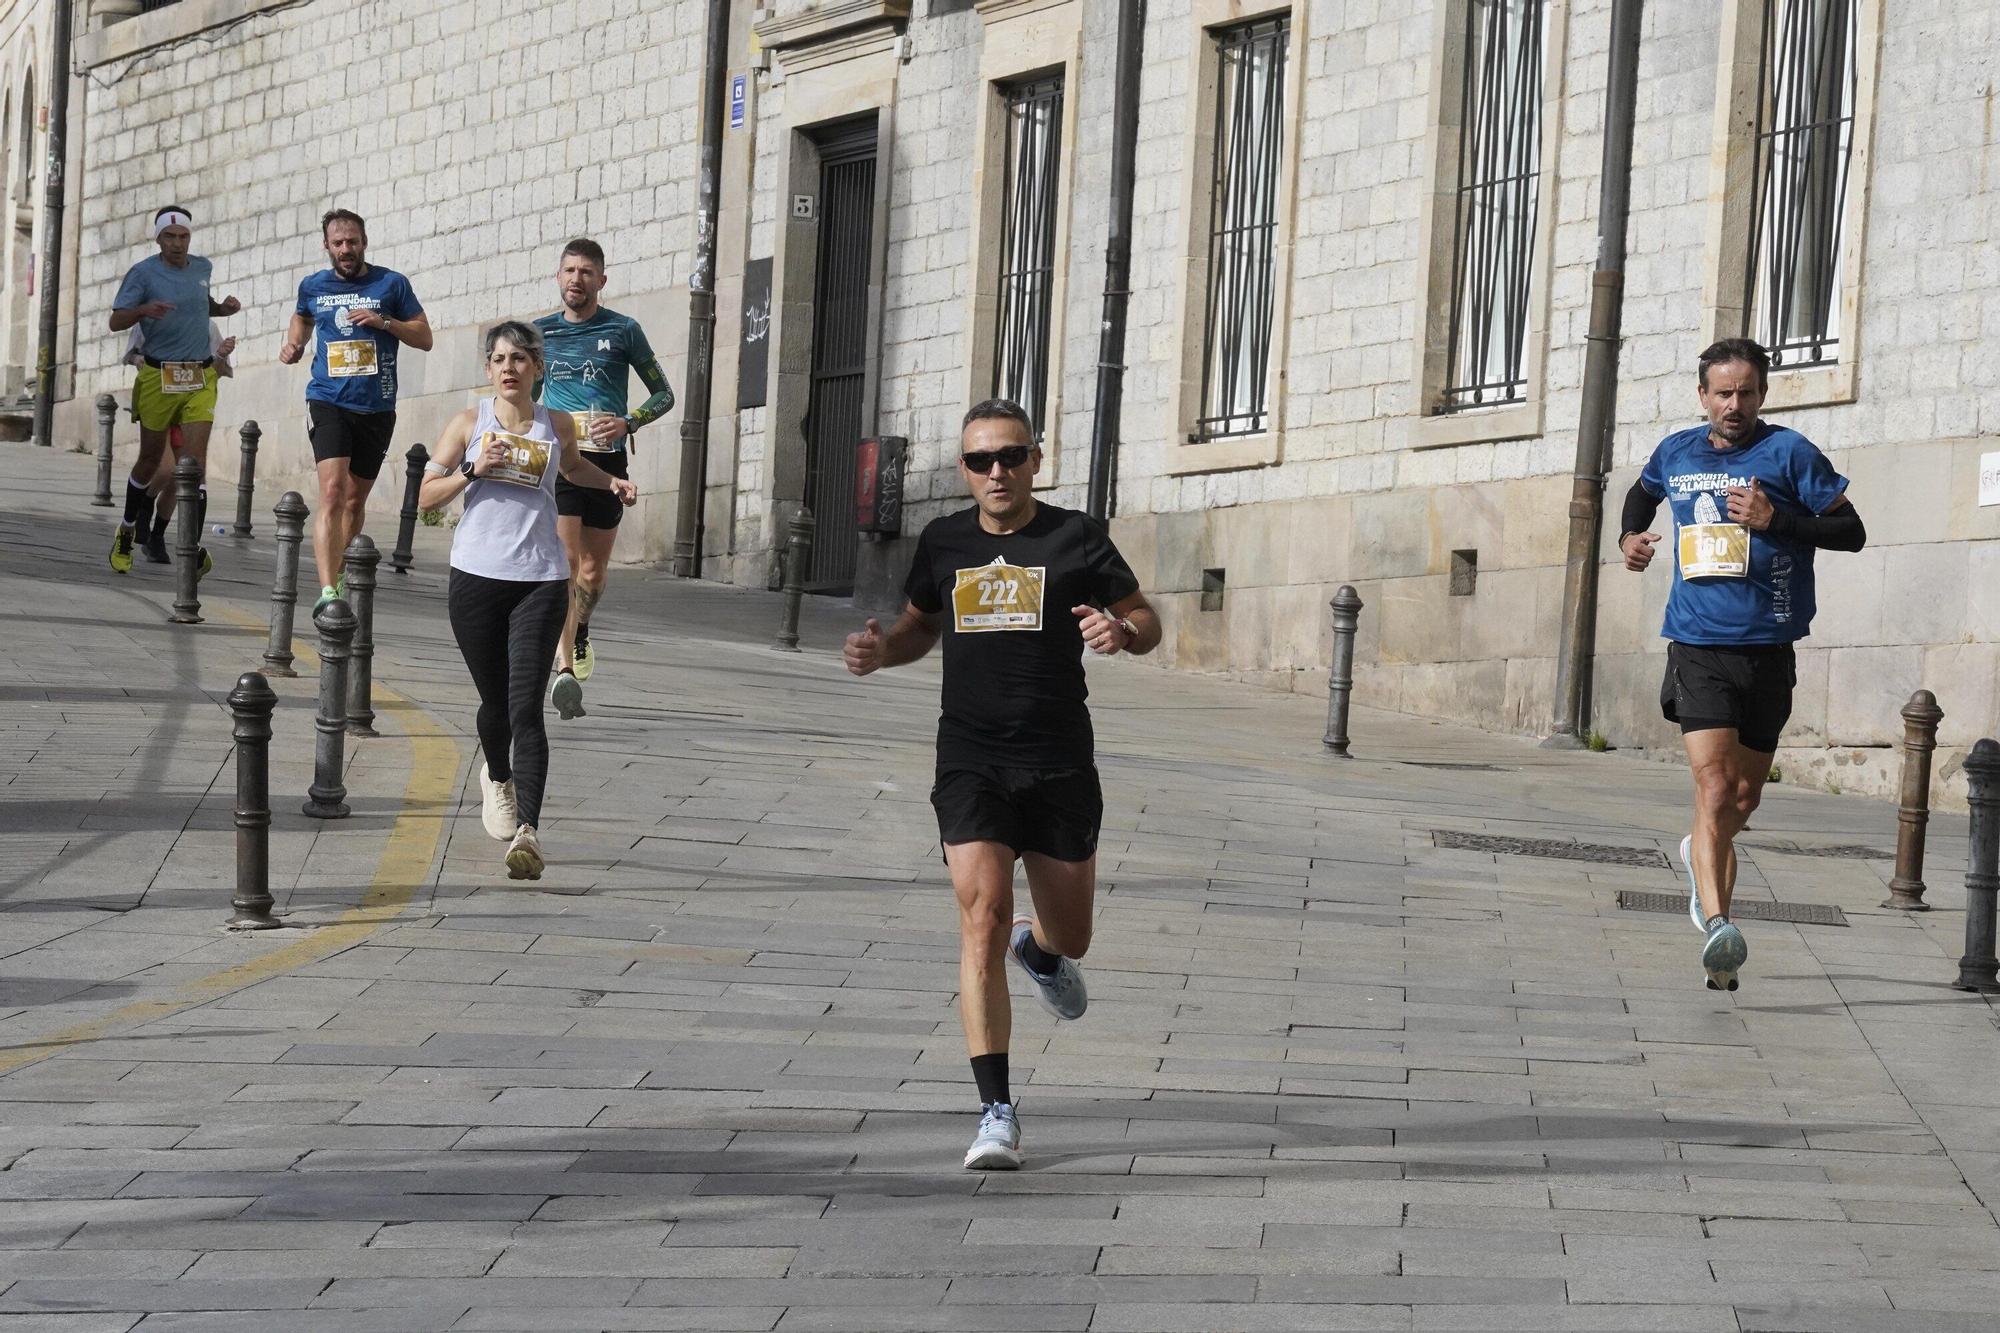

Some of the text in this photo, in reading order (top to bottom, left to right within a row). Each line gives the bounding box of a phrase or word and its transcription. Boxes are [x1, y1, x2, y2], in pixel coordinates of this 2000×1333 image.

[797, 198, 809, 214] 5
[324, 296, 372, 307] ALMENDRA
[173, 369, 194, 382] 523
[1668, 472, 1729, 483] LA CONQUISTA
[1678, 476, 1747, 493] ALMENDRA
[1694, 536, 1729, 556] 160
[977, 579, 1019, 606] 222
